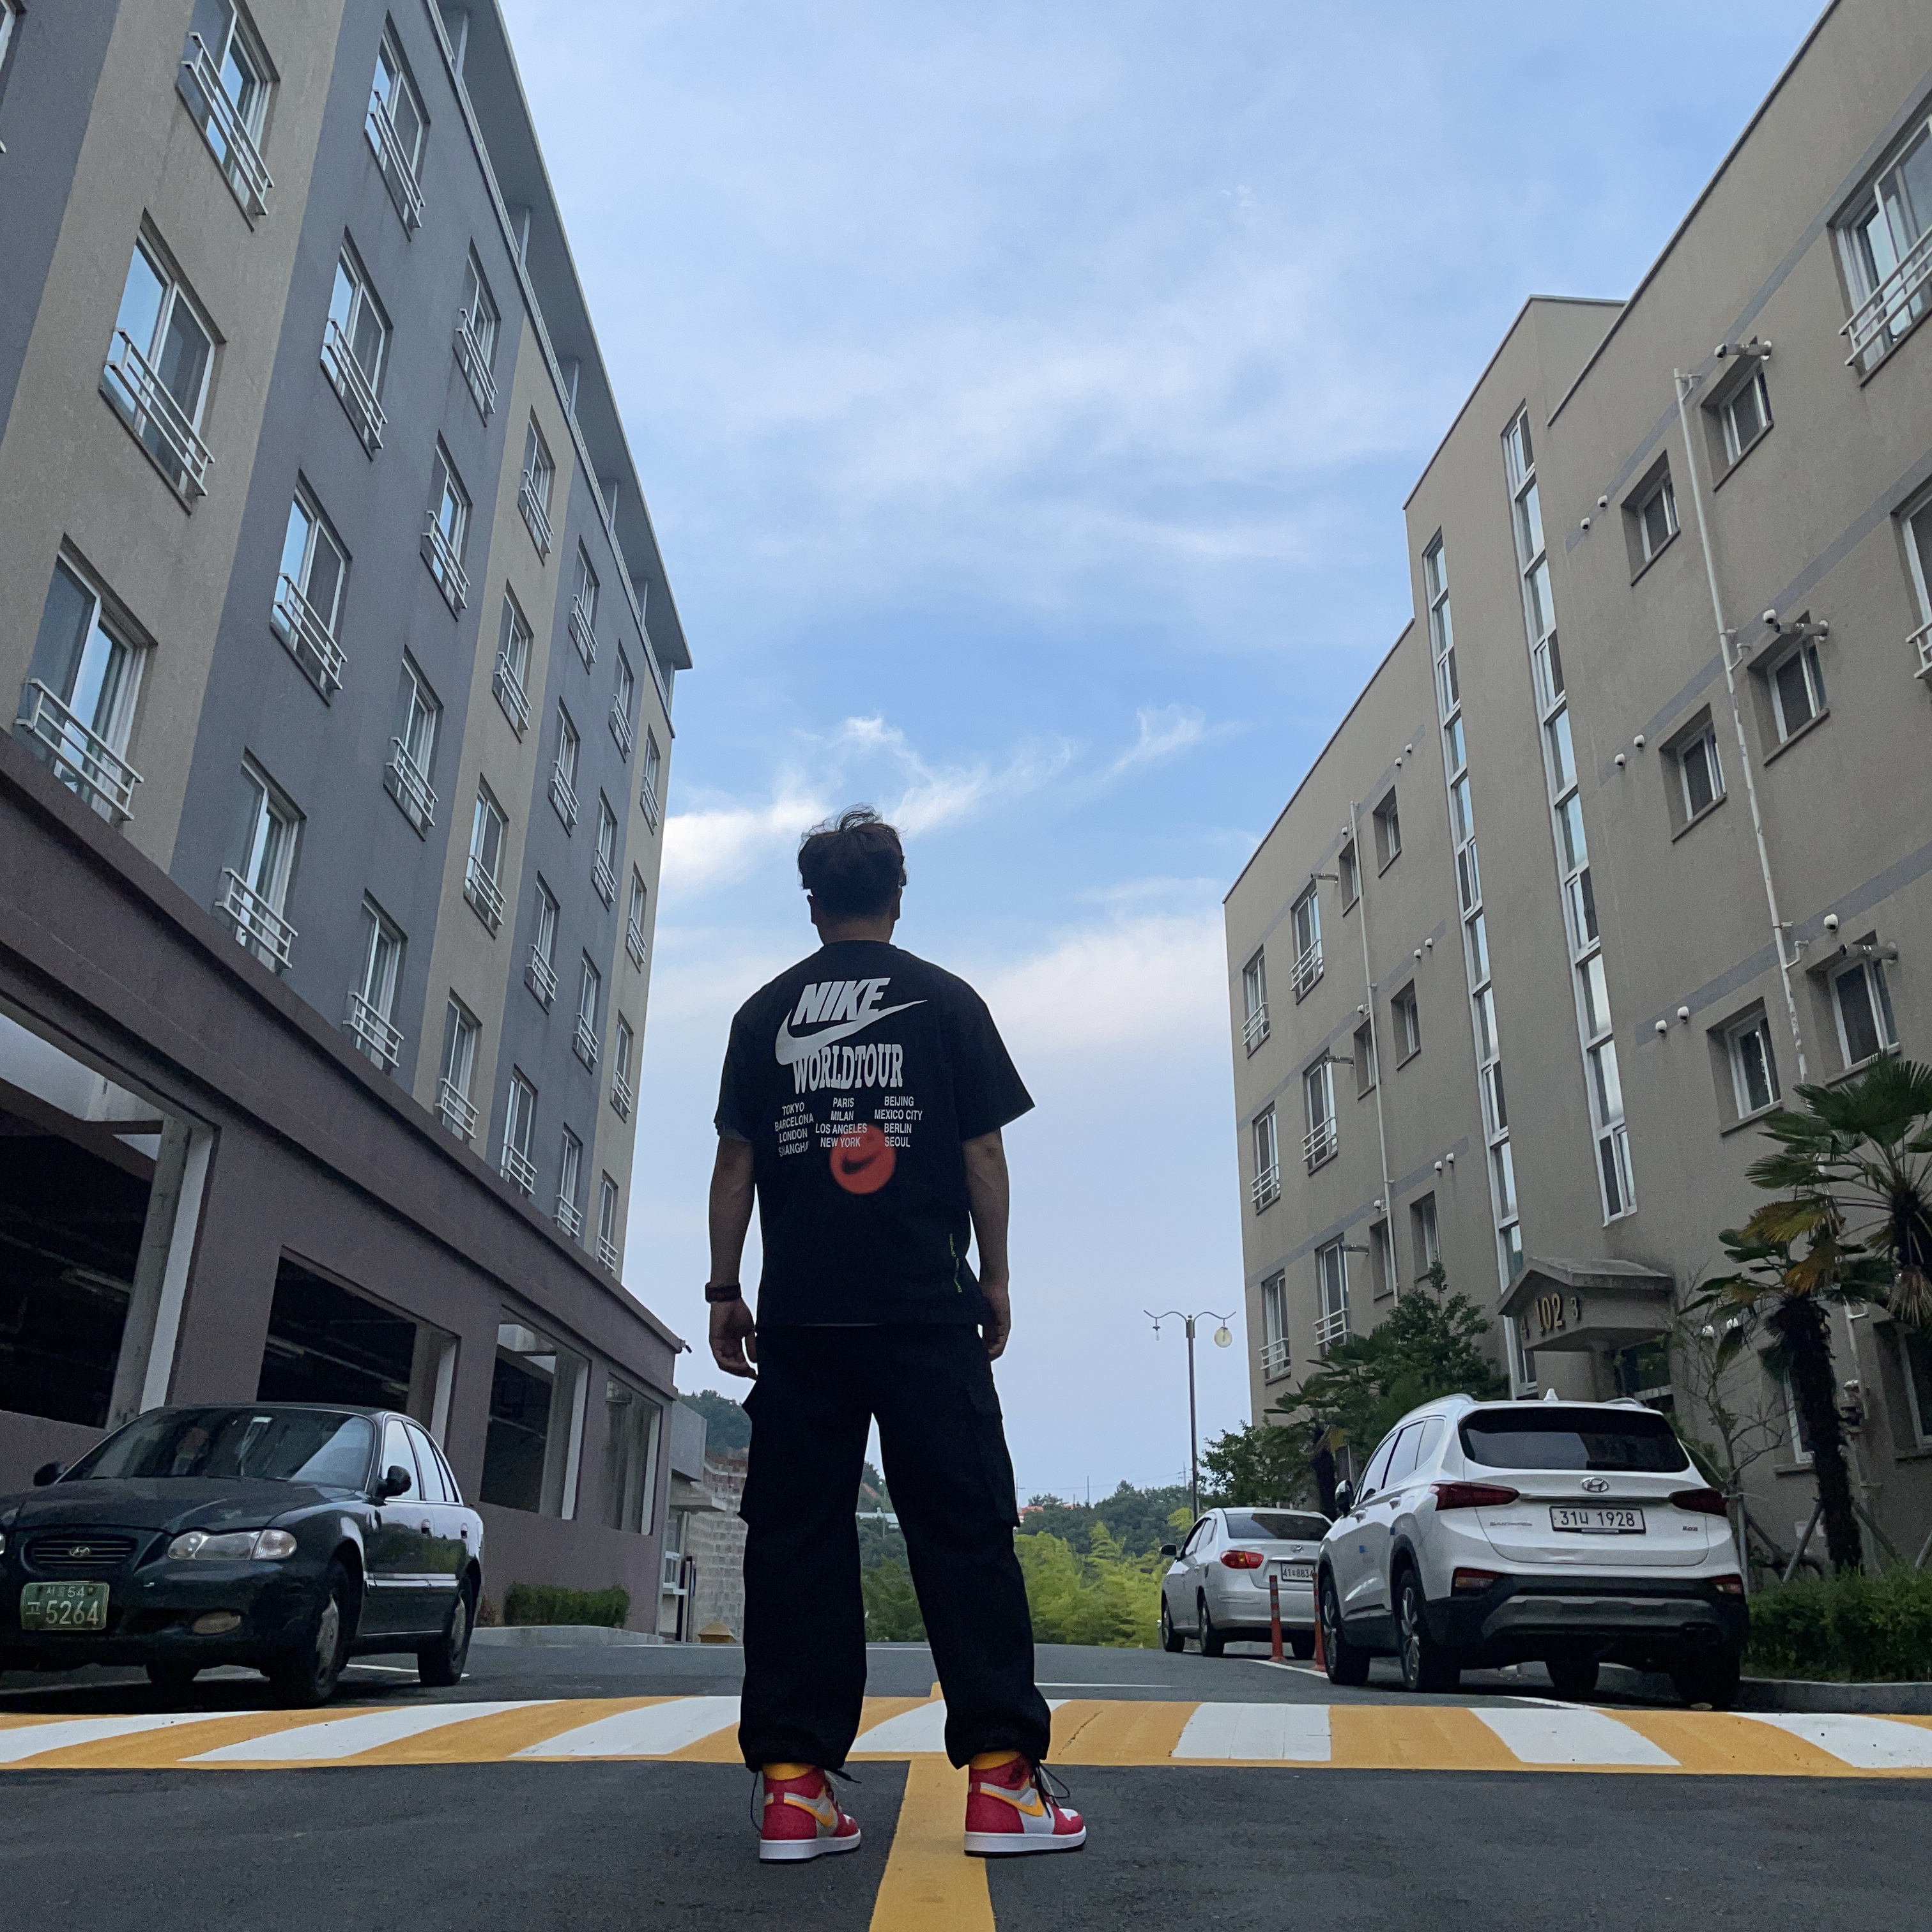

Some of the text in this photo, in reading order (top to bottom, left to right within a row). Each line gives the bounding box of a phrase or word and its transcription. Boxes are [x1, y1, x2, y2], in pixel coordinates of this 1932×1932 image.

[791, 977, 891, 1026] NIKE
[832, 1097, 854, 1108] PARIS
[884, 1096, 914, 1106] BEIJING
[782, 1101, 805, 1116] TOKYO
[831, 1110, 854, 1121] MILAN
[874, 1109, 923, 1121] MEXICO CITY
[774, 1113, 815, 1132] BARCELONA
[884, 1123, 912, 1133] BERLIN
[815, 1123, 868, 1134] LOS ANGELES
[779, 1128, 808, 1143] LONDON
[820, 1137, 861, 1147] NEW YORK
[884, 1137, 911, 1147] SEOUL
[1535, 1293, 1563, 1331] 102
[1570, 1297, 1578, 1319] 3
[1597, 1512, 1635, 1527] 1928
